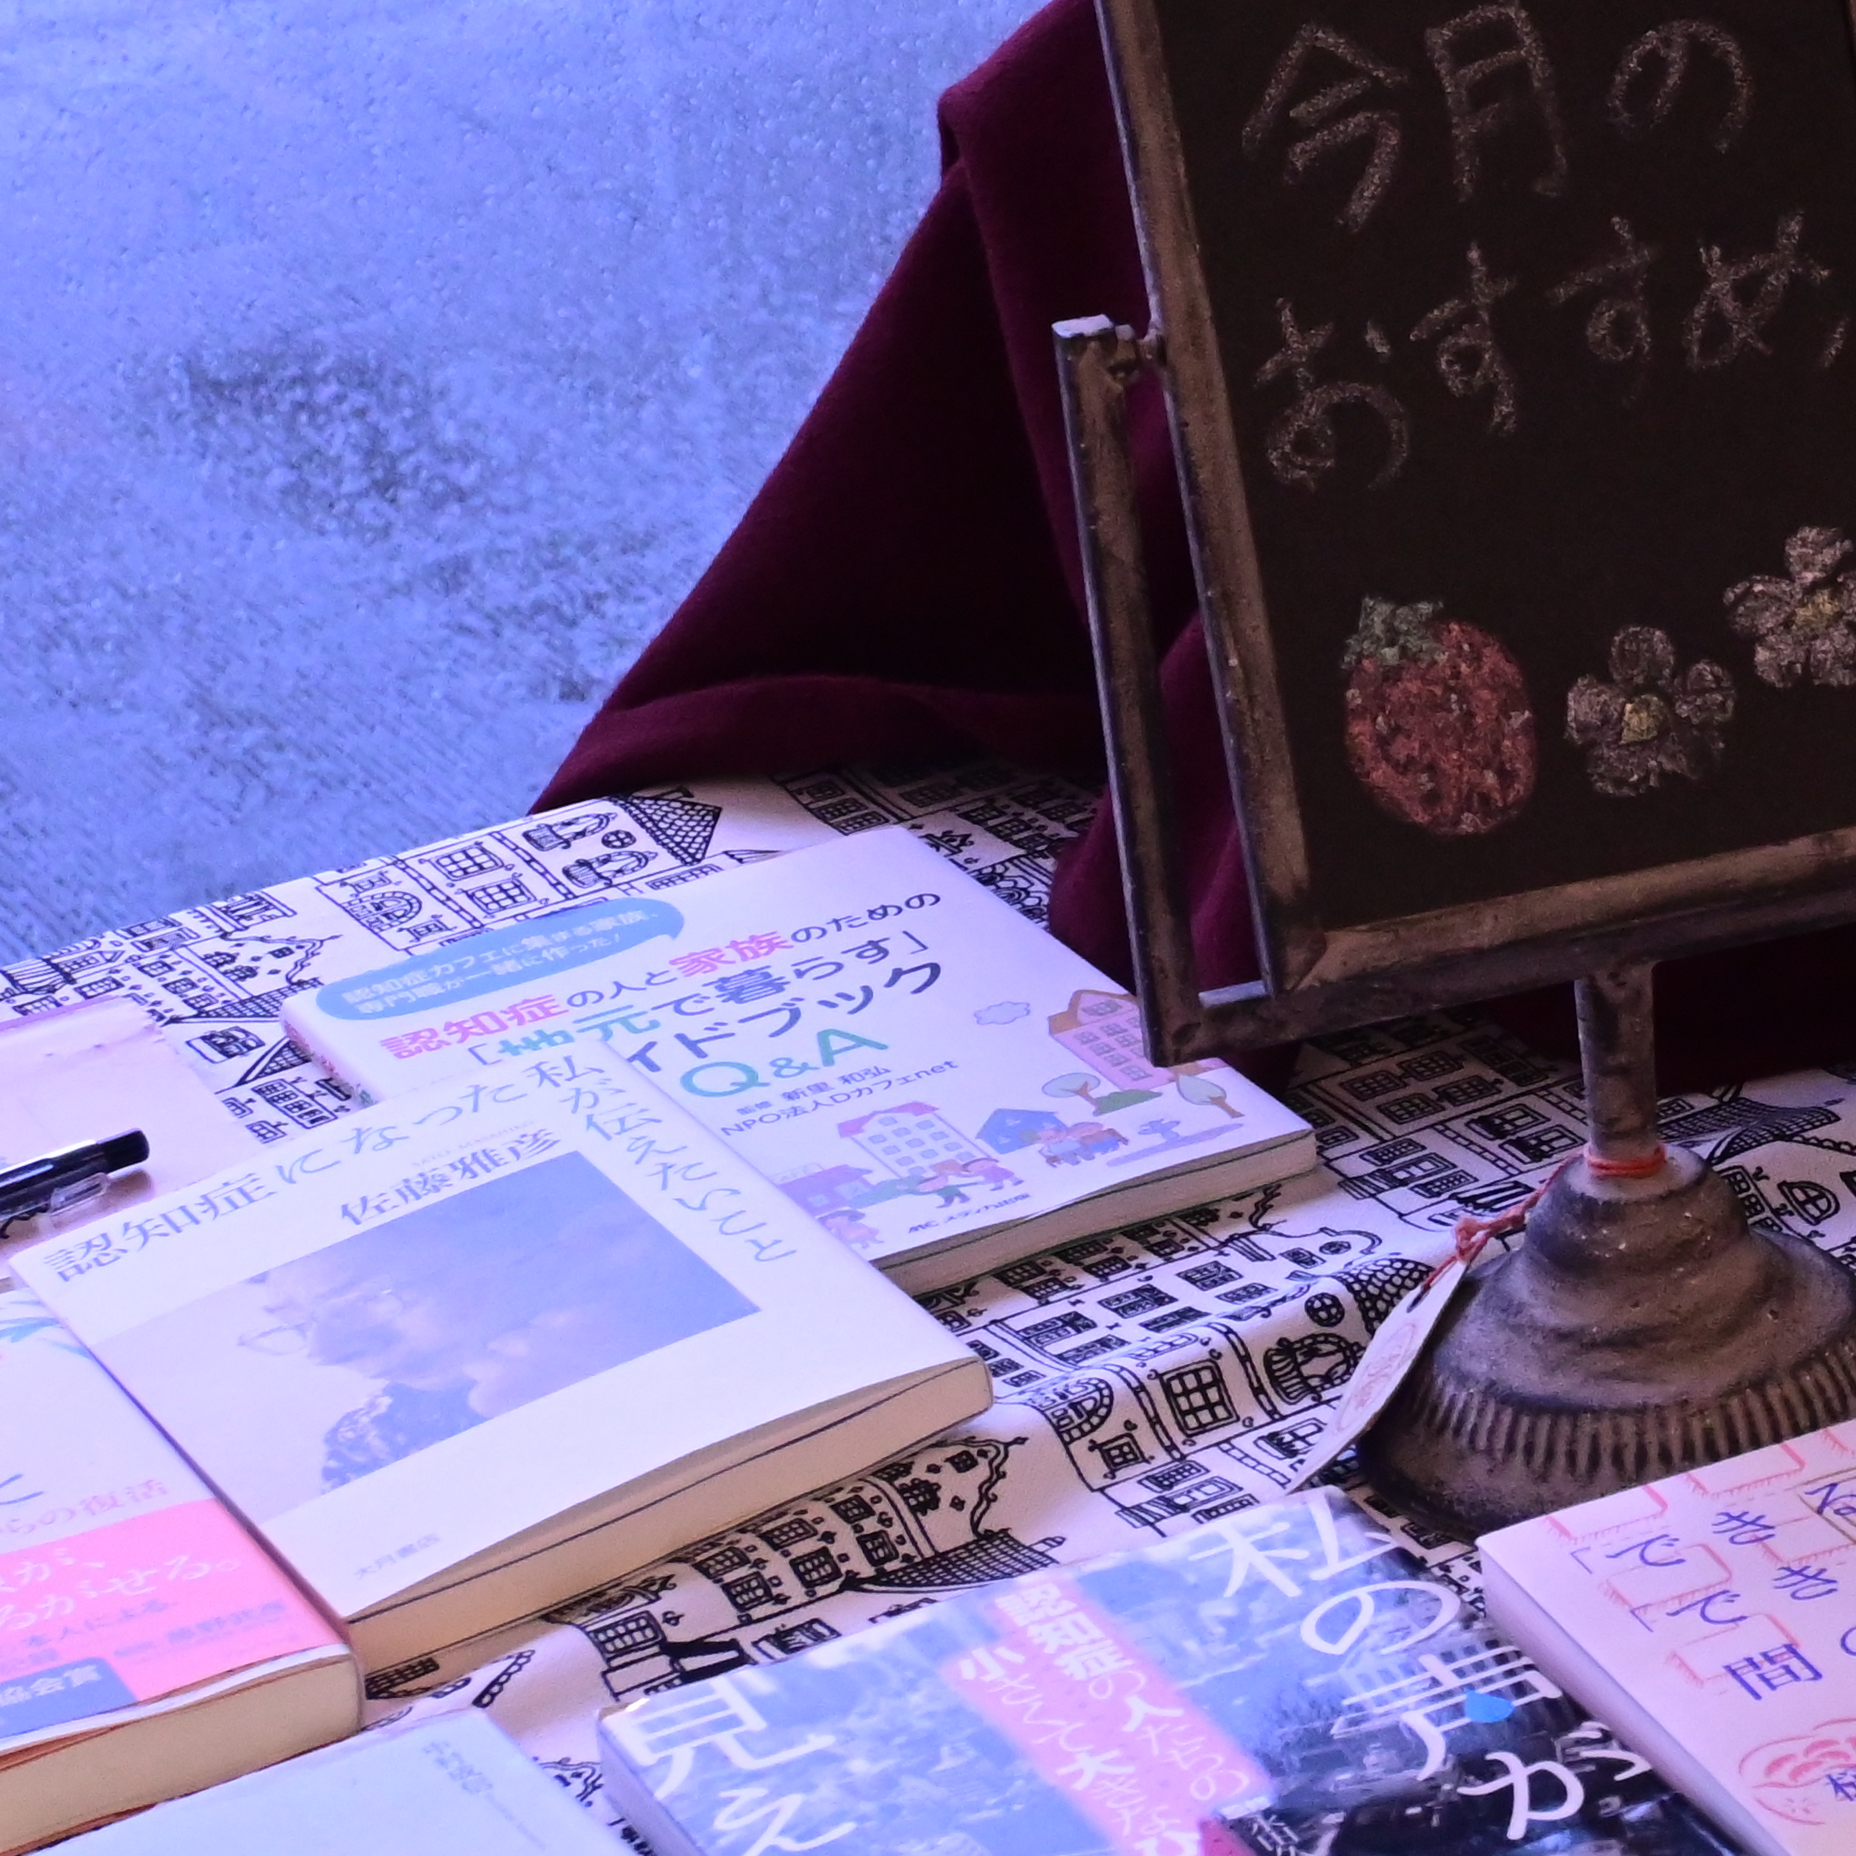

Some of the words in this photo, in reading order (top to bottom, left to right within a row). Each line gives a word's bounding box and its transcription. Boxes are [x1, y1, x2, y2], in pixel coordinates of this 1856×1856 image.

[1254, 211, 1849, 491] おすすめ
[380, 892, 942, 1061] 認知症の人と家族のための
[624, 960, 942, 1074] イドブック
[680, 1028, 889, 1099] Q&A
[720, 1060, 960, 1137] NPO法人Dカフェnet
[42, 1081, 529, 1284] 認知症になった
[340, 1125, 563, 1227] 佐藤雅彦
[524, 1053, 797, 1262] 私が伝えたいこと
[0, 1478, 169, 1536] らの復活
[1188, 1496, 1655, 1840] 私の声が
